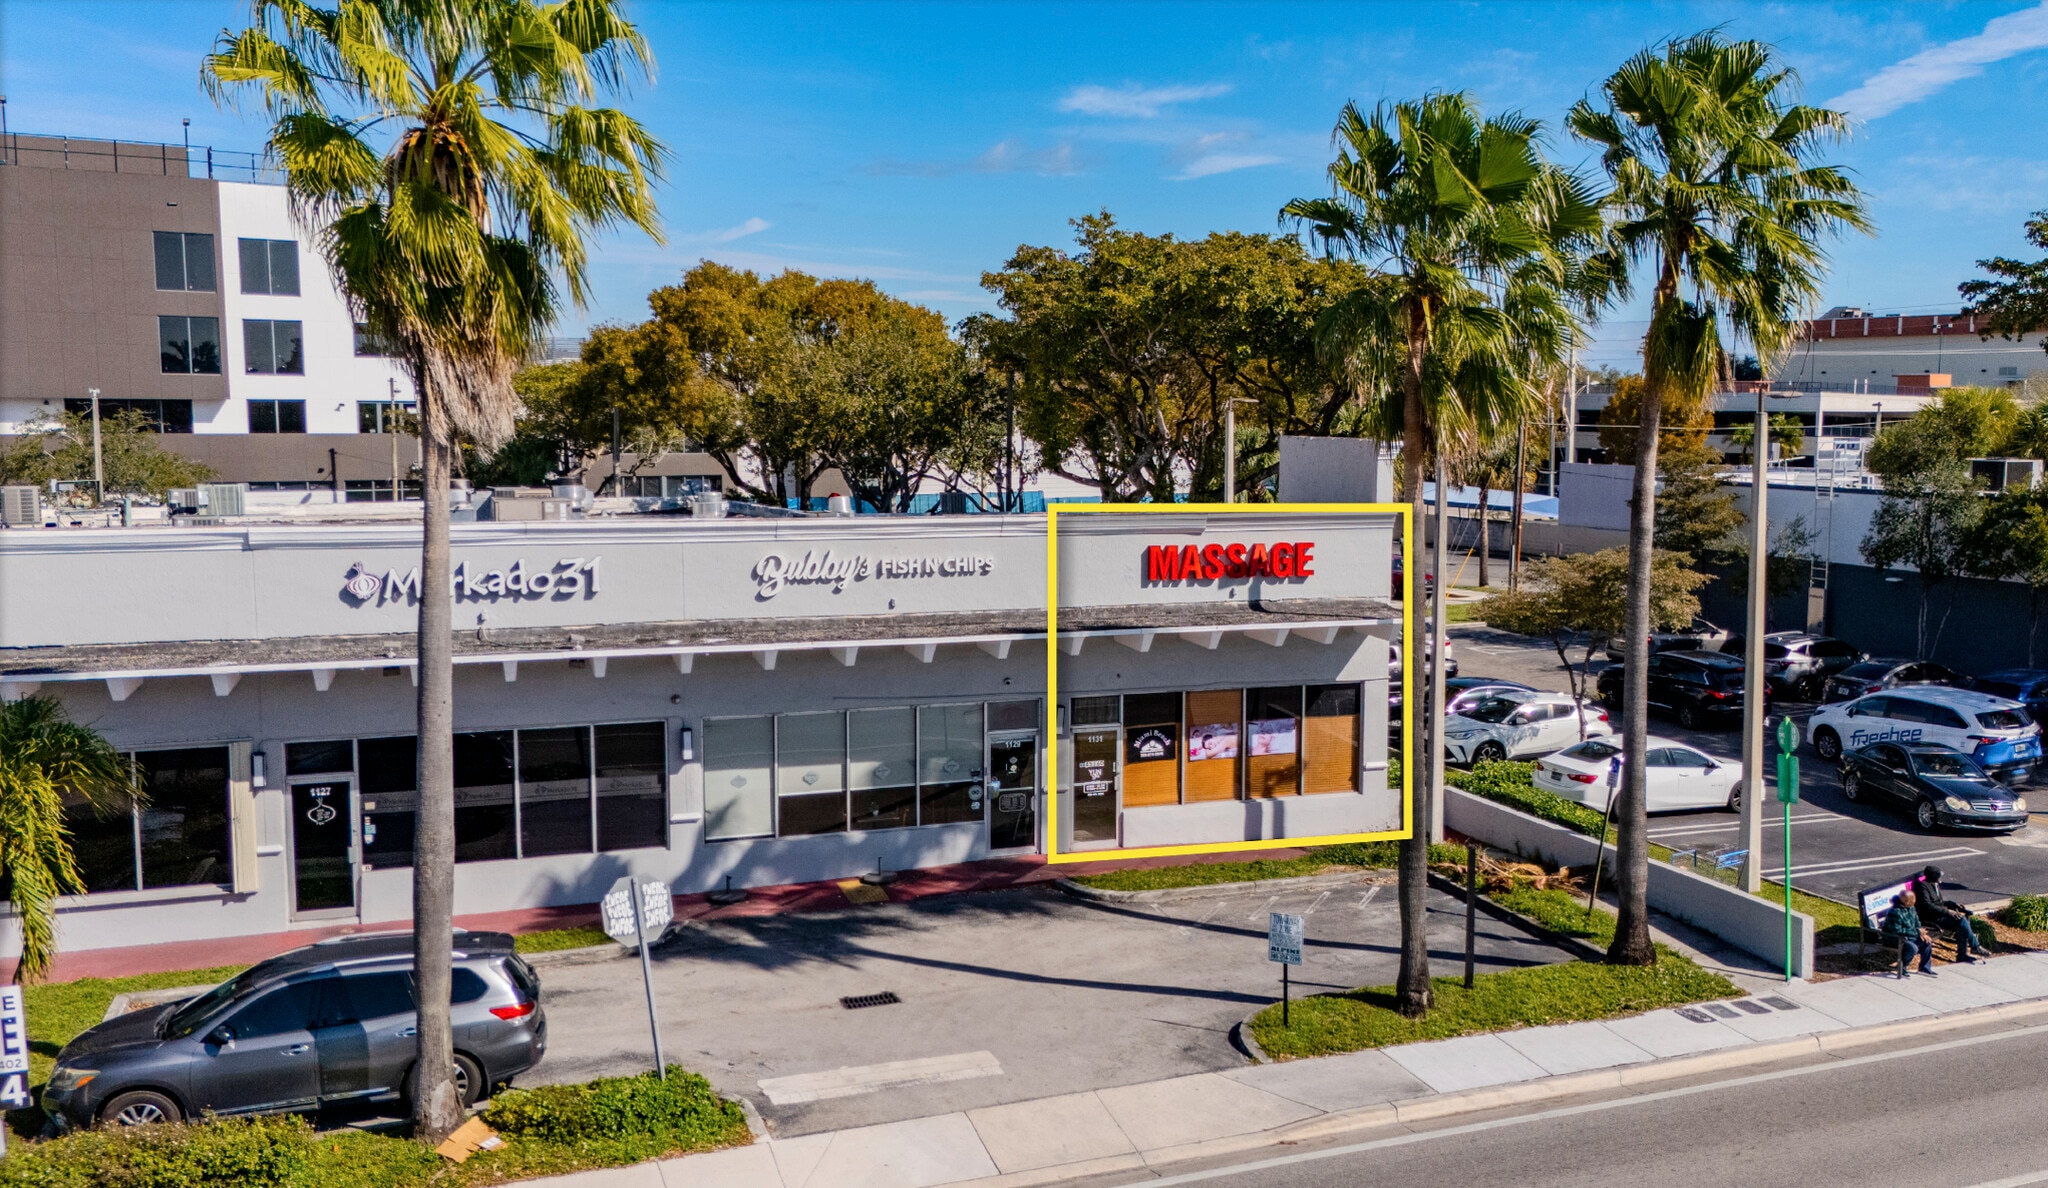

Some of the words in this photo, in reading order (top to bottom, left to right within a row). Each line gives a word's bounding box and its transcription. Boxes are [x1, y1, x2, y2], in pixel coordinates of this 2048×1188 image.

[1147, 541, 1315, 582] MASSAGE
[384, 555, 602, 598] Mrkado31
[757, 550, 872, 597] Bubby's
[881, 559, 920, 575] FISH
[942, 556, 996, 573] CHIPS
[1005, 740, 1021, 748] 1129
[1088, 735, 1104, 743] 1131
[1133, 729, 1153, 748] Miami
[1153, 729, 1172, 746] Beach
[309, 787, 331, 796] 1127
[1271, 946, 1301, 954] ALPINE
[0, 1074, 27, 1107] 4
